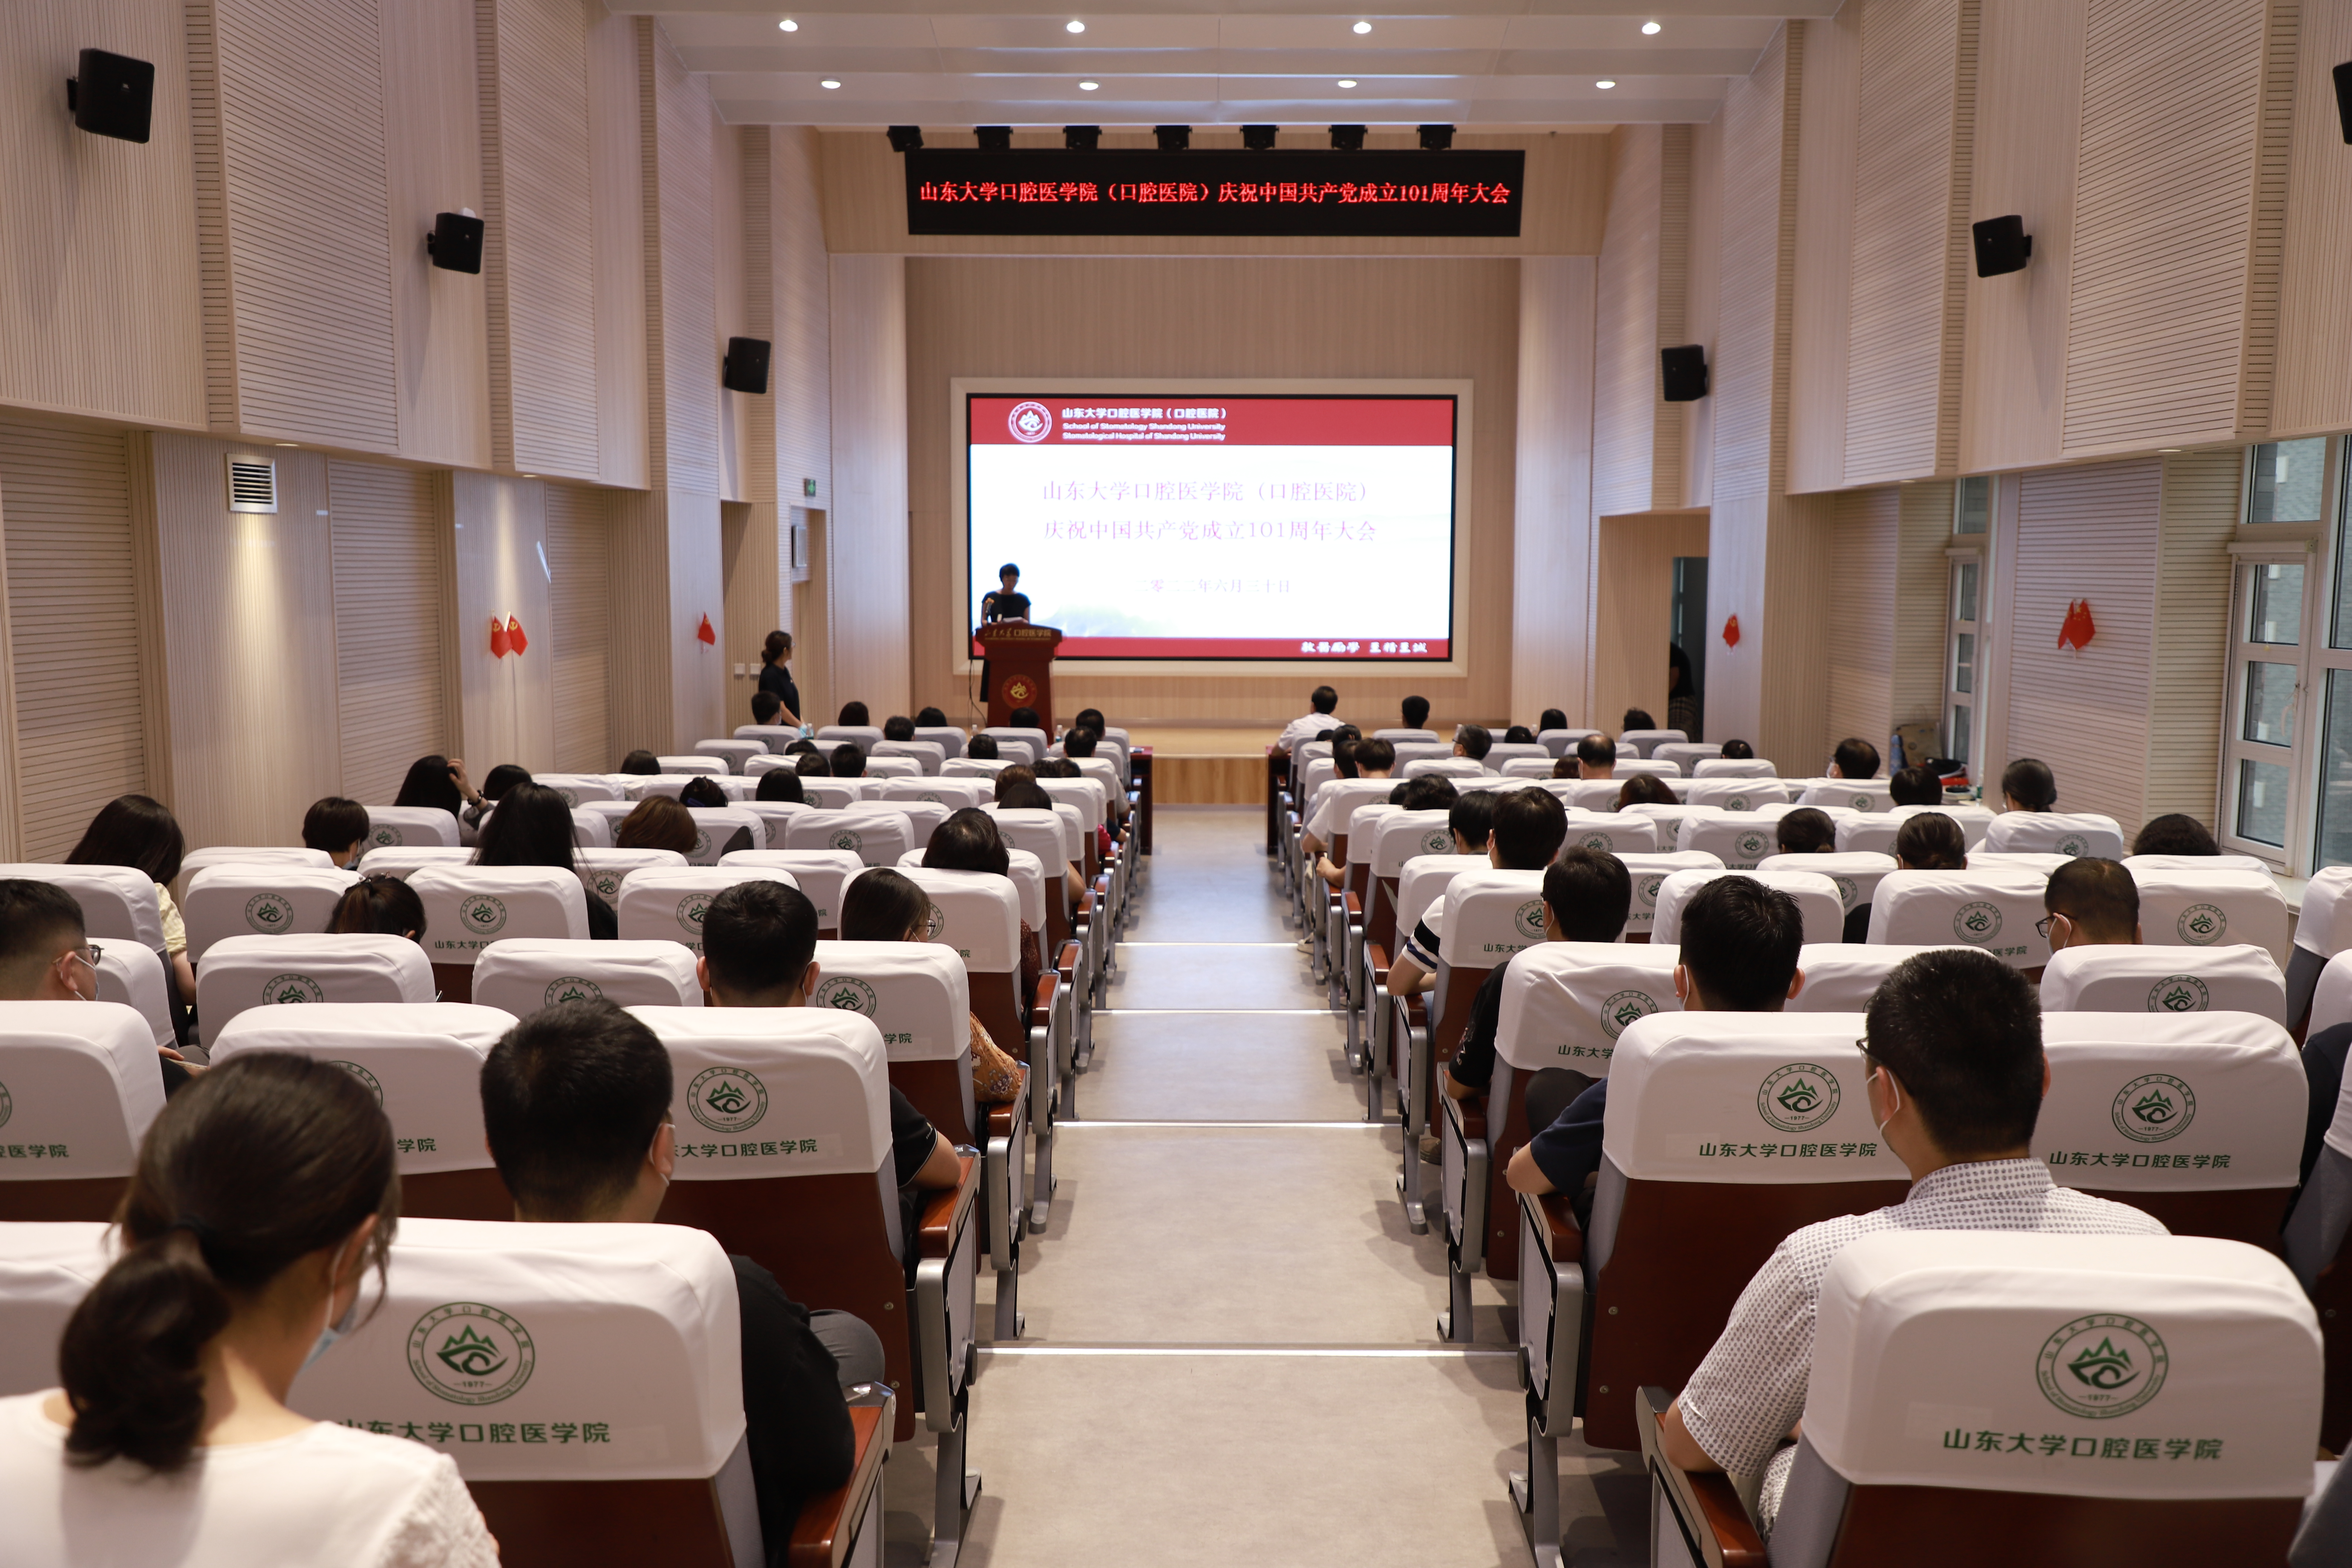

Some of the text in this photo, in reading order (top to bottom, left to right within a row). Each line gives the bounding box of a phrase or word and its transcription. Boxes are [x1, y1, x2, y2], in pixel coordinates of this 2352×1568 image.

[920, 181, 1511, 204] 山东大学口腔医学院（口腔医院）庆祝中国共产党成立101周年大会
[1062, 407, 1227, 419] 山东大学口腔医学院（口腔医院）
[1100, 423, 1148, 431] Stomatology
[1187, 423, 1226, 431] University
[1063, 432, 1115, 441] Stomatological
[1153, 432, 1189, 441] Shandong
[1043, 481, 1367, 502] 山东大学口腔医学院（口腔医院）
[1044, 520, 1376, 541] 庆祝中国共产党成立101周年大会
[1134, 579, 1289, 593] 二零二二年六月三十日
[1558, 1044, 1614, 1059] 山东大学
[675, 1138, 818, 1158] 大学口腔医学院
[1699, 1142, 1878, 1158] 山东大学口腔医学院
[2049, 1151, 2231, 1169] 山东大学口腔医学院
[1943, 1428, 2224, 1461] 山东大学口腔医学院
